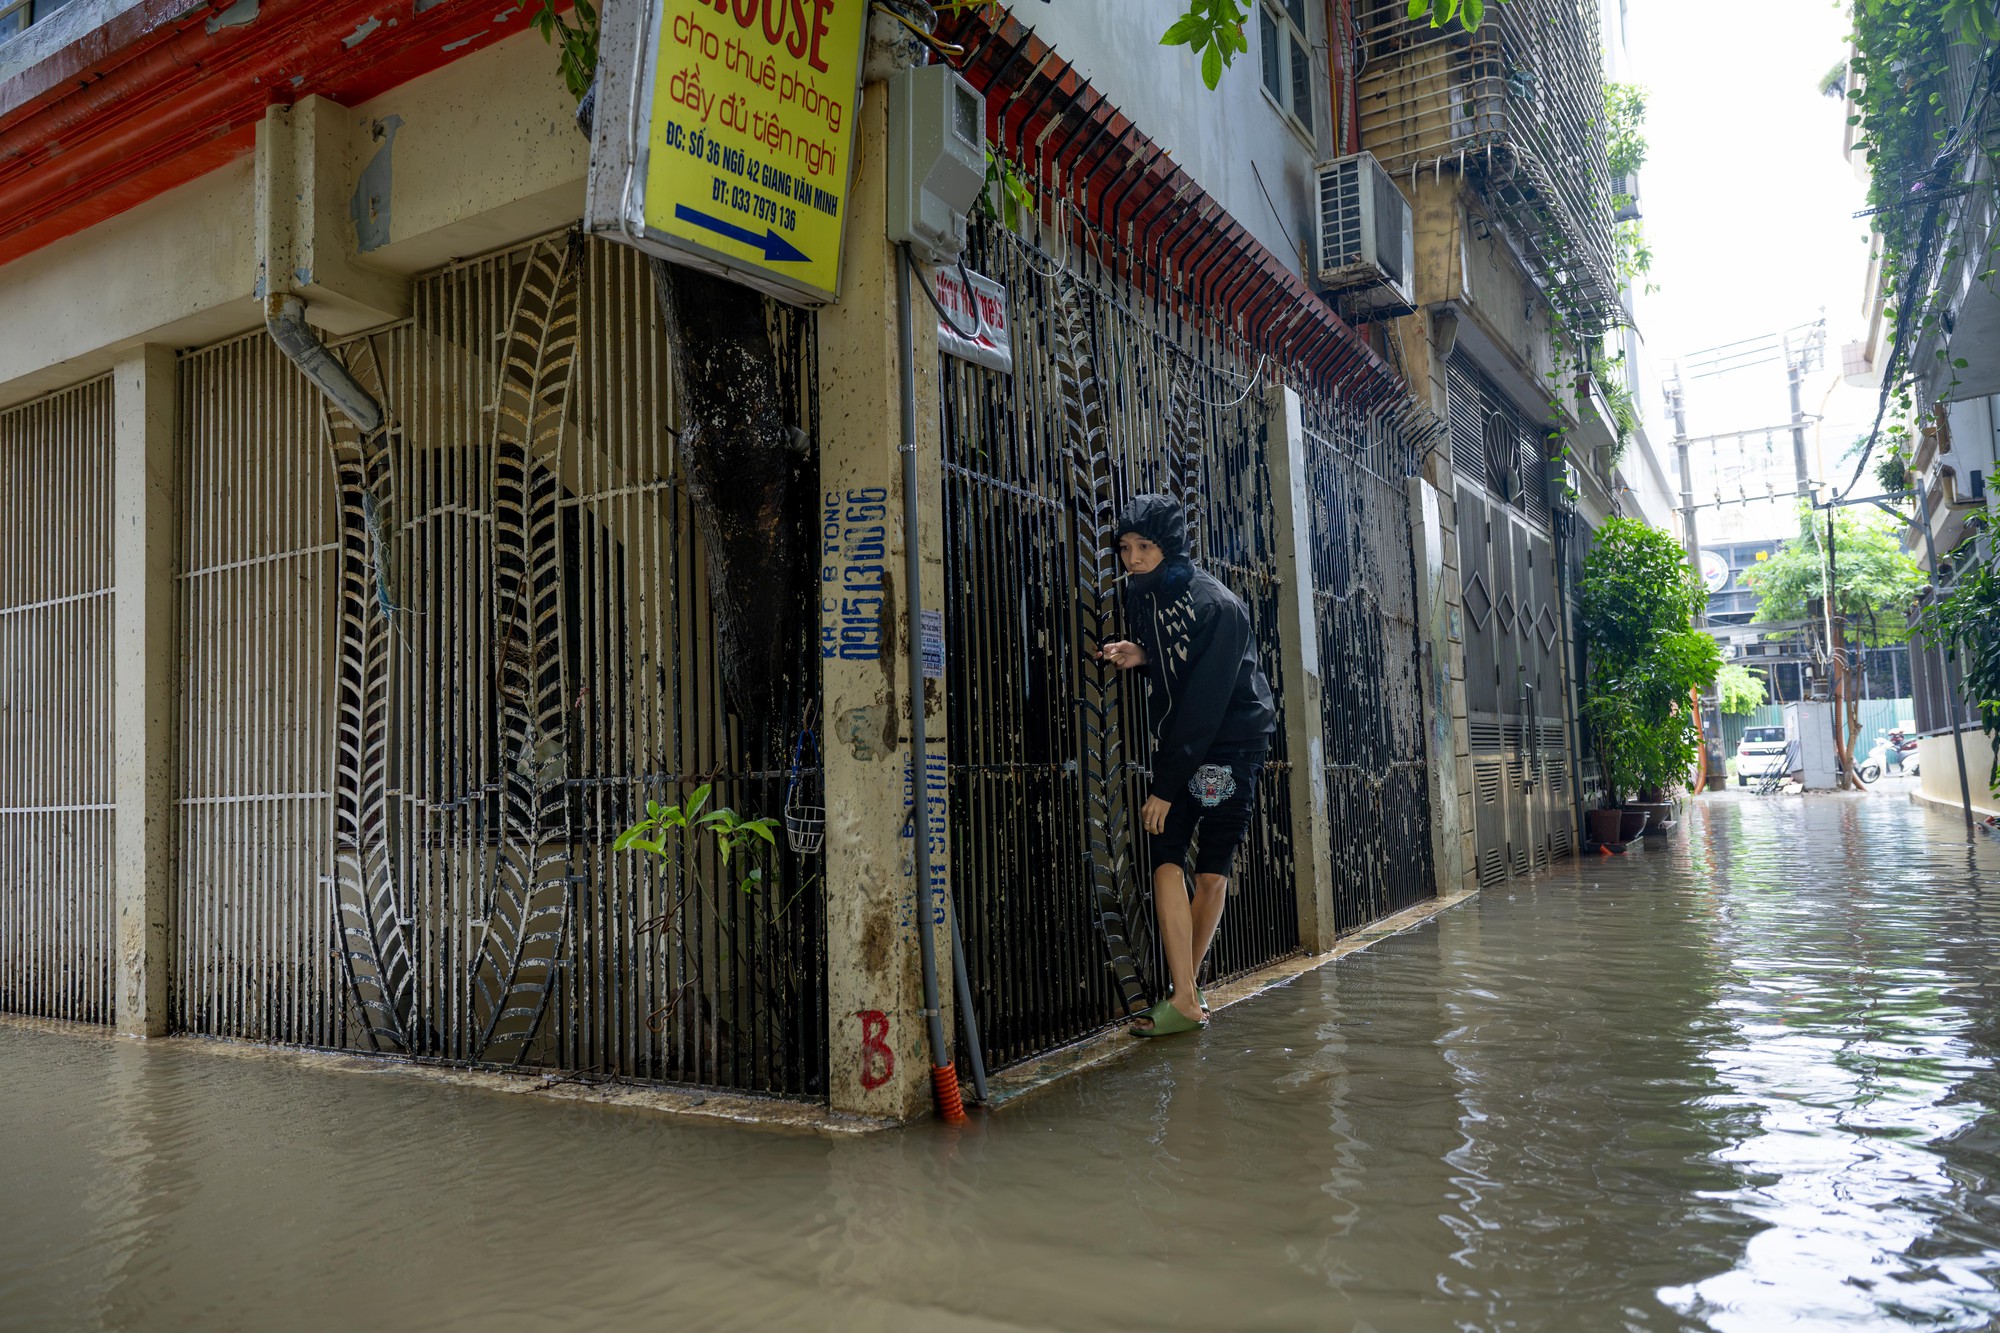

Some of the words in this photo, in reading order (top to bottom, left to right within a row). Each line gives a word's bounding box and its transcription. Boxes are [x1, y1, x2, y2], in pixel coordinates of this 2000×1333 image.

[670, 62, 715, 123] đầy
[719, 92, 748, 134] đủ
[753, 110, 792, 155] tiện
[796, 136, 836, 176] nghi
[673, 11, 719, 60] cho
[725, 38, 776, 91] thuê
[779, 70, 842, 133] phòng
[666, 120, 685, 152] ĐC:
[689, 128, 706, 159] SỐ
[706, 139, 720, 166] 36
[722, 146, 744, 176] NGÕ
[746, 158, 760, 183] 42
[762, 164, 791, 197] GIANG
[794, 176, 812, 206] VĂN
[813, 187, 839, 217] MINH
[712, 177, 729, 205] ĐT:
[731, 186, 751, 214] 033
[753, 194, 777, 224] 7979
[780, 205, 796, 232] 136
[857, 1009, 895, 1092] B
